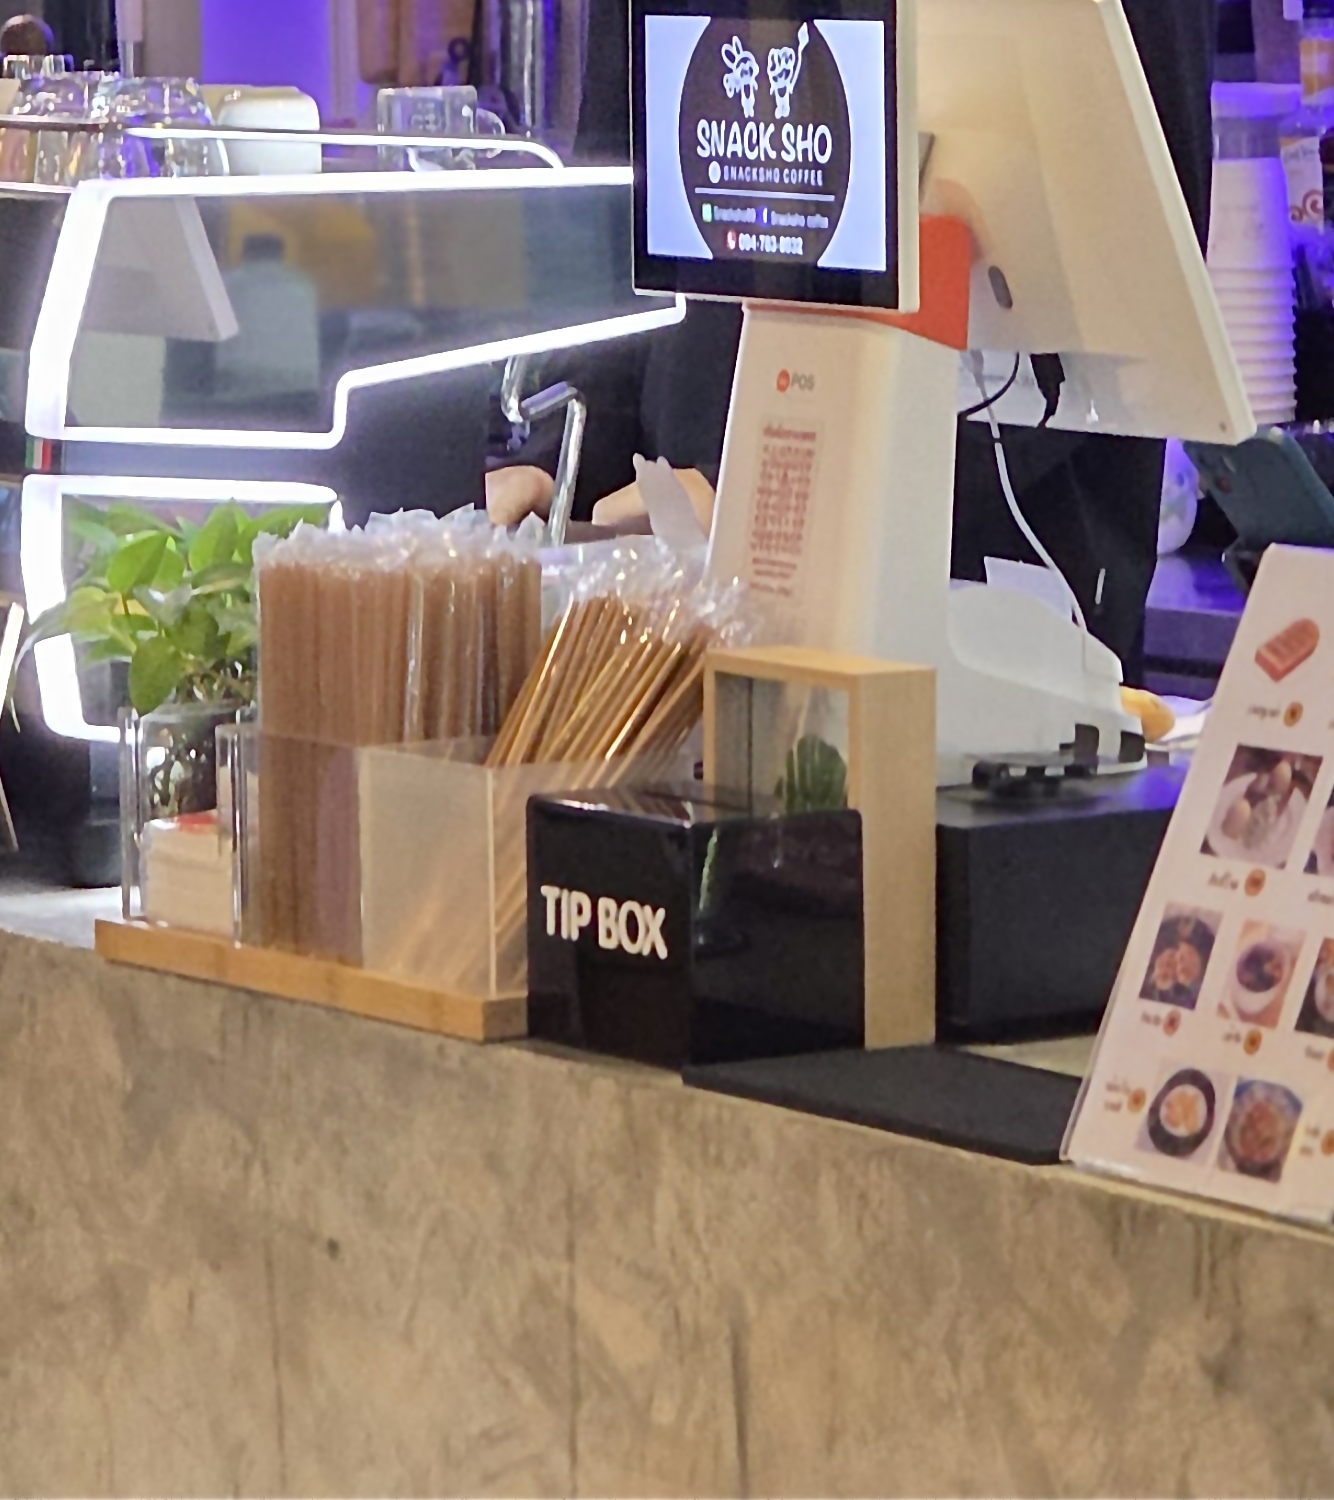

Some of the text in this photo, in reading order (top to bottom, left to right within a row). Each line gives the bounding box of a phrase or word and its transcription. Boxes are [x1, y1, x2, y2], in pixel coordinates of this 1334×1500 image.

[696, 118, 833, 164] SNACK SHO
[723, 165, 824, 187] SNACKSHO COFFEE
[791, 372, 815, 391] POS
[540, 884, 670, 961] TIP BOX
